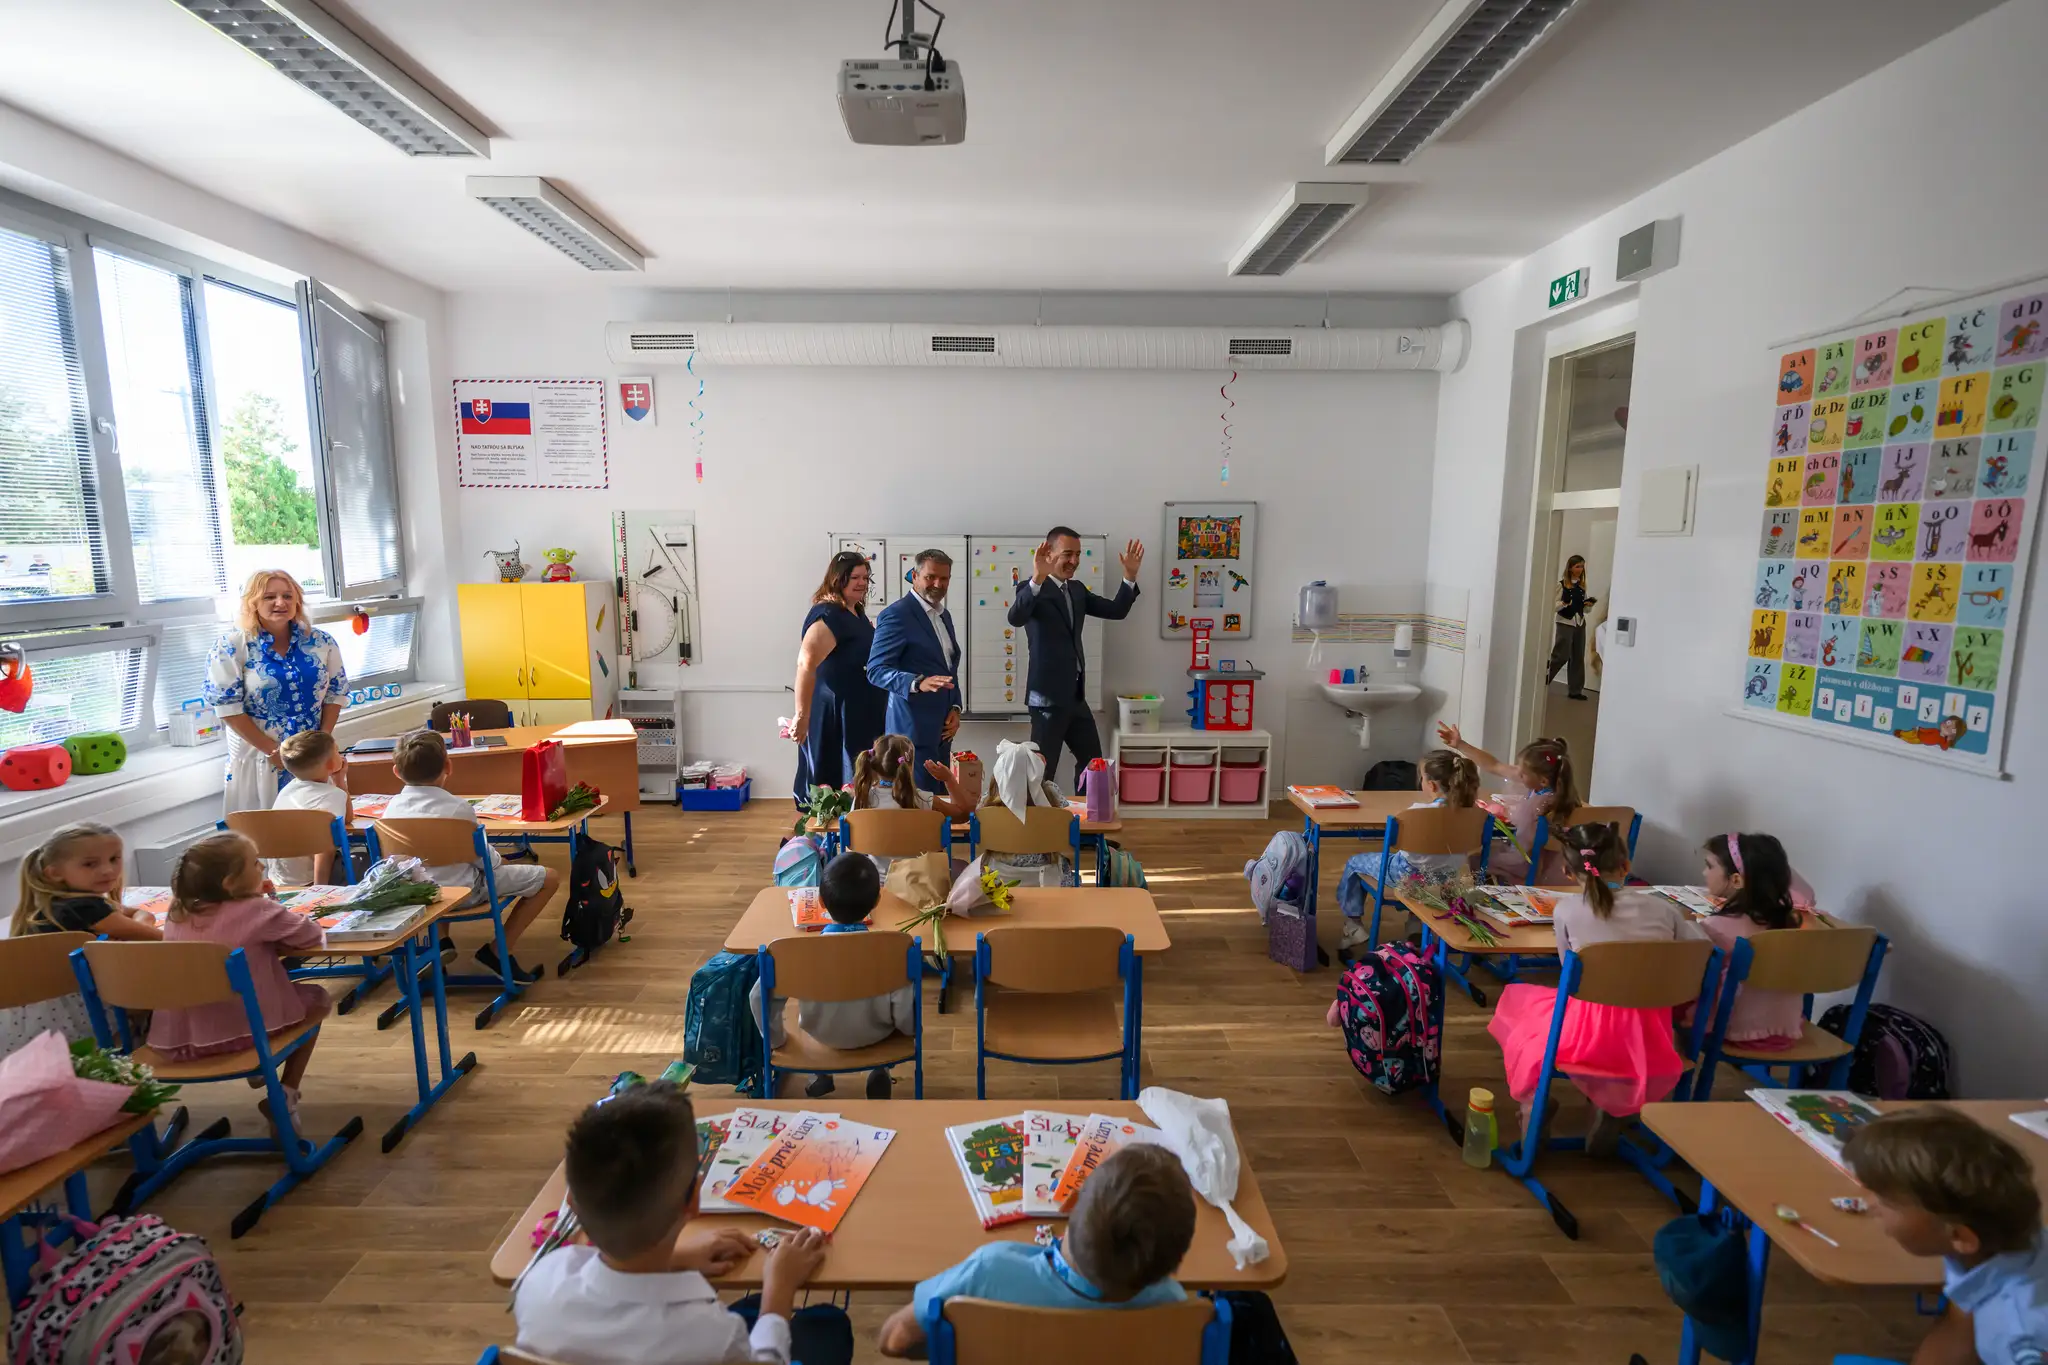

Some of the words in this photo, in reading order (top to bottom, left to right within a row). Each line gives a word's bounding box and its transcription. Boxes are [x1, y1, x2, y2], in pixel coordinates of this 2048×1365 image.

[2013, 304, 2023, 318] d
[2028, 300, 2042, 314] D
[1960, 316, 1968, 330] č
[1972, 309, 1986, 327] Č
[1922, 325, 1934, 338] C
[1865, 338, 1872, 351] b
[1876, 336, 1887, 349] B
[1790, 360, 1796, 368] a
[1798, 355, 1807, 366] A
[1954, 380, 1962, 394] f
[1965, 378, 1976, 392] F
[2002, 375, 2012, 390] g
[2018, 368, 2033, 384] G
[1851, 398, 1864, 410] dž
[1868, 392, 1887, 408] Dž
[1902, 392, 1910, 402] e
[1914, 387, 1925, 400] E
[1795, 405, 1804, 420] Ď
[1814, 404, 1826, 416] dz
[1830, 402, 1844, 414] Dz
[1941, 444, 1951, 458] k
[1956, 442, 1969, 456] K
[2008, 437, 2018, 452] L
[1808, 458, 1818, 470] ch
[1822, 456, 1838, 468] Ch
[1896, 449, 1902, 464] j
[1905, 448, 1913, 460] J
[1778, 462, 1784, 472] h
[1788, 460, 1797, 472] H
[1842, 512, 1850, 522] n
[1853, 510, 1864, 522] N
[1885, 508, 1893, 520] ň
[1897, 504, 1908, 520] Ň
[1932, 510, 1940, 520] o
[1945, 506, 1958, 520] O
[1984, 504, 1992, 518] ô
[1998, 500, 2012, 518] Ô
[1804, 514, 1814, 523] m
[1816, 511, 1828, 522] M
[1767, 566, 1774, 576] p
[1778, 564, 1785, 574] P
[1800, 568, 1807, 578] q
[1810, 564, 1820, 578] Q
[1836, 568, 1843, 577] r
[1846, 566, 1856, 577] R
[1880, 569, 1885, 579] s
[1889, 567, 1898, 580] S
[1926, 568, 1932, 580] š
[1937, 564, 1946, 580] Š
[1978, 570, 1984, 582] t
[1988, 568, 2002, 582] T
[1795, 618, 1802, 628] u
[1804, 617, 1814, 628] U
[1832, 622, 1838, 631] v
[1840, 620, 1851, 631] V
[1867, 625, 1878, 636] w
[1882, 624, 1897, 636] W
[1916, 630, 1924, 640] x
[1928, 628, 1940, 642] X
[1965, 635, 1974, 648] y
[1980, 632, 1992, 647] Y
[1754, 664, 1760, 674] z
[1763, 664, 1772, 675] Z
[1790, 668, 1796, 680] ž
[1798, 666, 1806, 680] Ž
[1904, 692, 1912, 704] ú
[1924, 704, 1933, 719] ý
[735, 1111, 788, 1135] Šlab
[1030, 1114, 1081, 1138] Šlab
[736, 1131, 742, 1140] 1
[1036, 1134, 1042, 1142] 1
[1088, 1119, 1118, 1144] čiary
[976, 1141, 1023, 1159] VESE
[1083, 1142, 1103, 1170] prvé
[735, 1167, 776, 1200] Moje
[770, 1140, 796, 1170] prvé
[787, 1116, 822, 1141] čiary
[981, 1155, 1019, 1172] PRV
